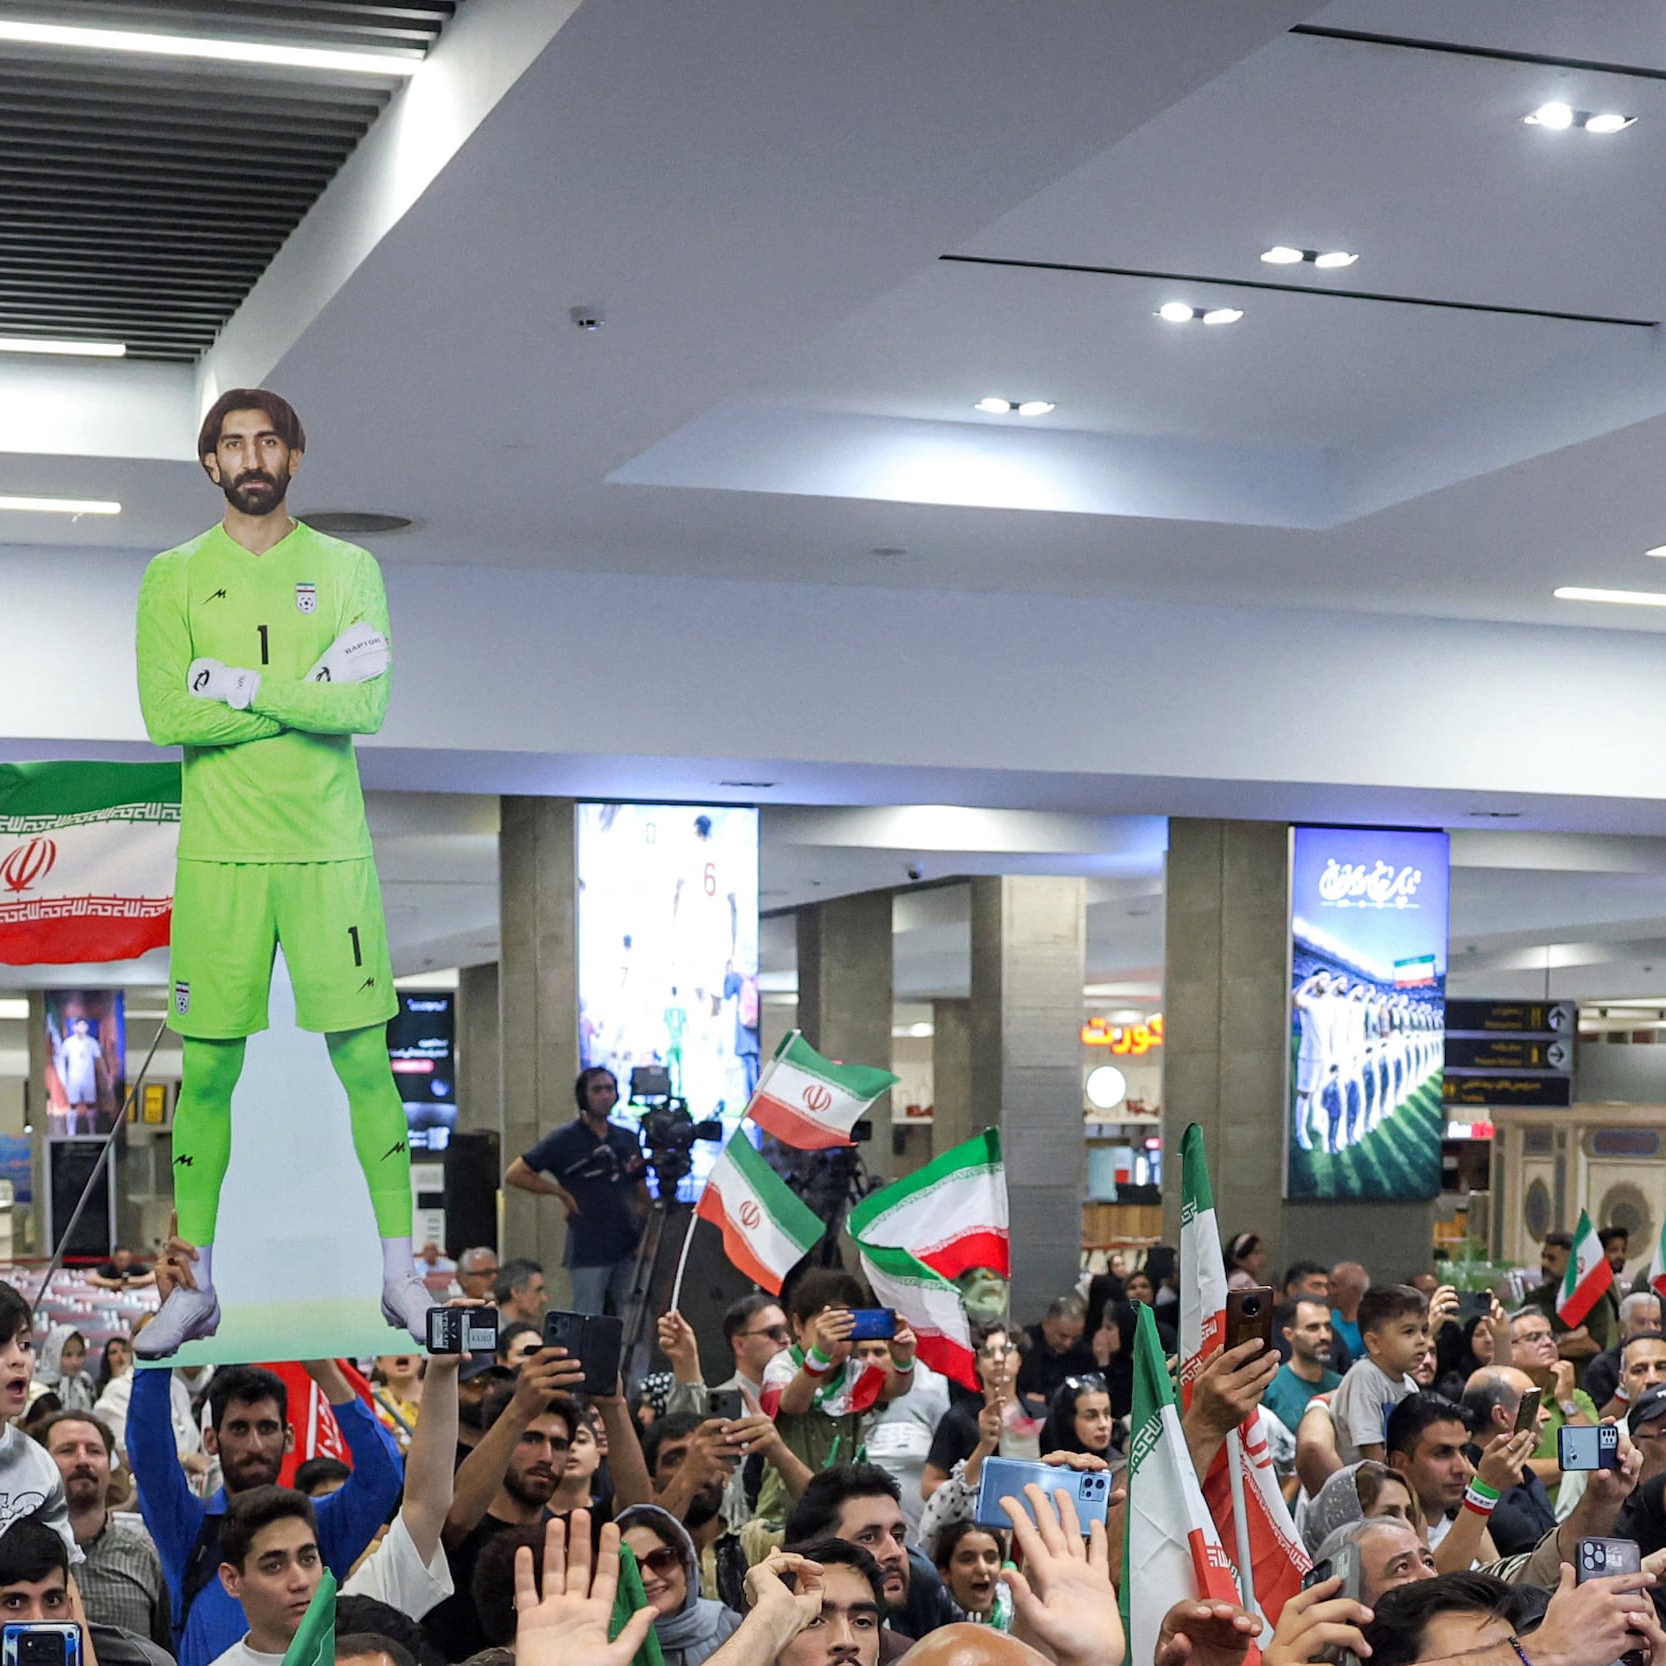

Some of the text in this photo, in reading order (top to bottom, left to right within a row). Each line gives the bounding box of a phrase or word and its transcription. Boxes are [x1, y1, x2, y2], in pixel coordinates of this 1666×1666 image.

[257, 624, 269, 665] 1
[703, 861, 717, 897] 6
[347, 925, 362, 967] 1
